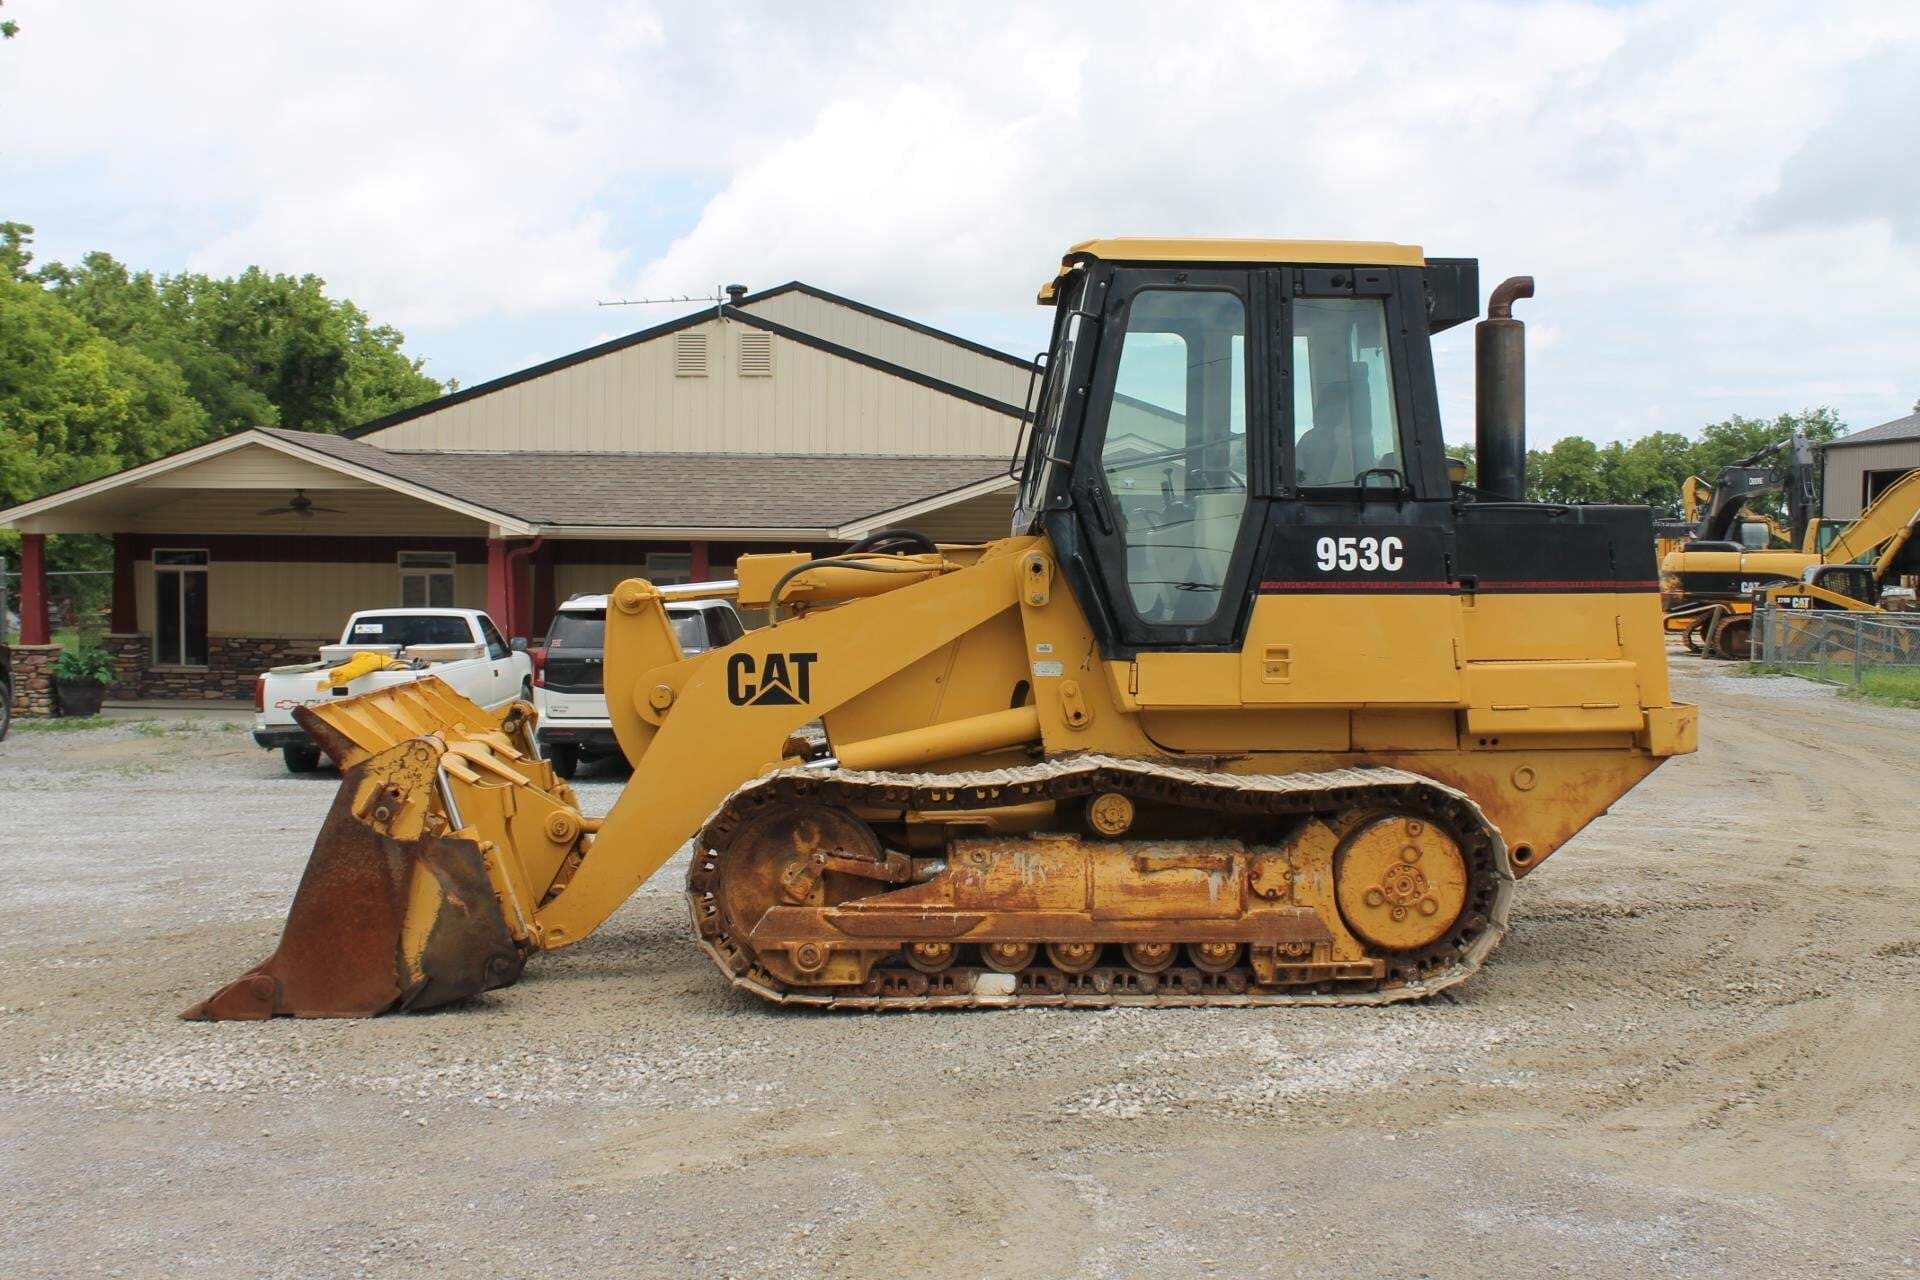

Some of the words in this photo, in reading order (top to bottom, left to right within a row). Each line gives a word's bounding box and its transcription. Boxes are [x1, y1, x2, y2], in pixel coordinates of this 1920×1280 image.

[1316, 536, 1403, 572] 953C
[1741, 582, 1761, 593] CAT
[1792, 597, 1810, 608] CAT
[727, 652, 818, 706] CAT
